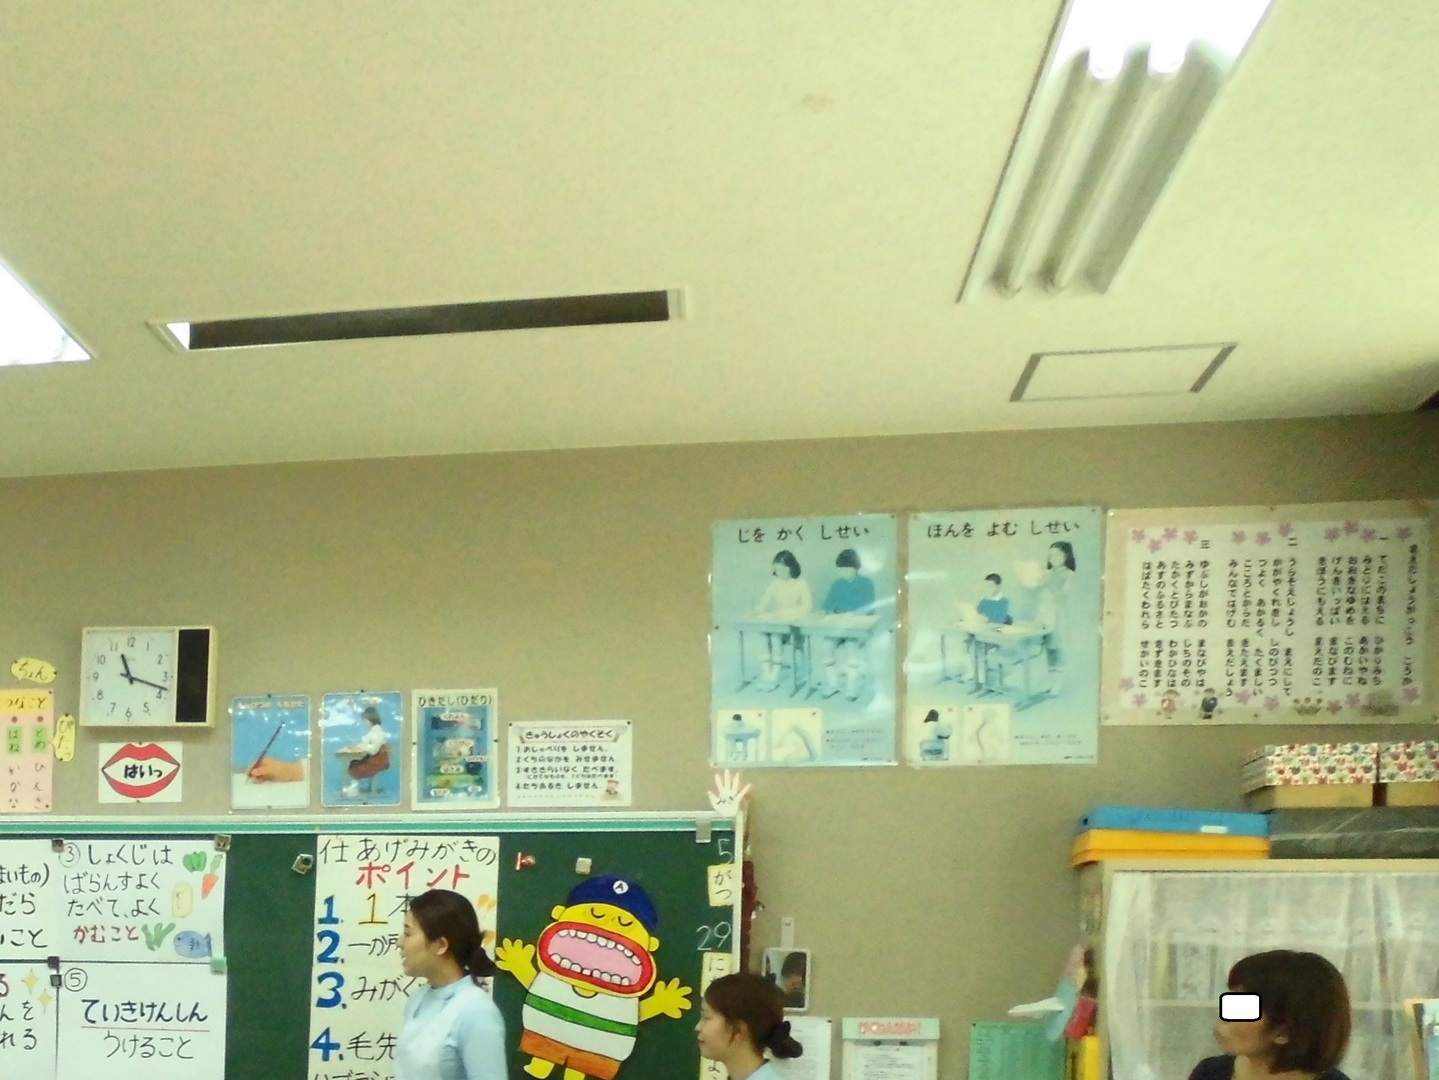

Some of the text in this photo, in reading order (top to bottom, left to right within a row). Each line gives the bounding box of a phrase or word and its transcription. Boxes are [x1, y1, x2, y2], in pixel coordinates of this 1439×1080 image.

[738, 525, 869, 543] じを かく しせい
[928, 520, 1080, 538] ほんを よむ しせい
[110, 642, 118, 651] 11
[127, 637, 136, 647] 12
[146, 641, 150, 651] 1
[97, 655, 106, 665] 10
[157, 654, 164, 665] 2
[93, 672, 99, 682] 9
[162, 671, 168, 682] 3
[97, 689, 103, 700] 8
[110, 703, 117, 714] 7
[125, 708, 132, 718] 6
[143, 703, 150, 713] 5
[525, 729, 613, 740] きゅうしょくのやくそく
[124, 764, 163, 779] はいっ
[717, 839, 733, 864] 5
[356, 862, 470, 889] ポイント
[64, 871, 160, 894] ばらんすよく
[714, 869, 732, 900] がつ
[73, 925, 139, 944] かむこと
[696, 922, 732, 950] 29
[81, 999, 208, 1024] ていきけんしん
[104, 1030, 194, 1059] うけること
